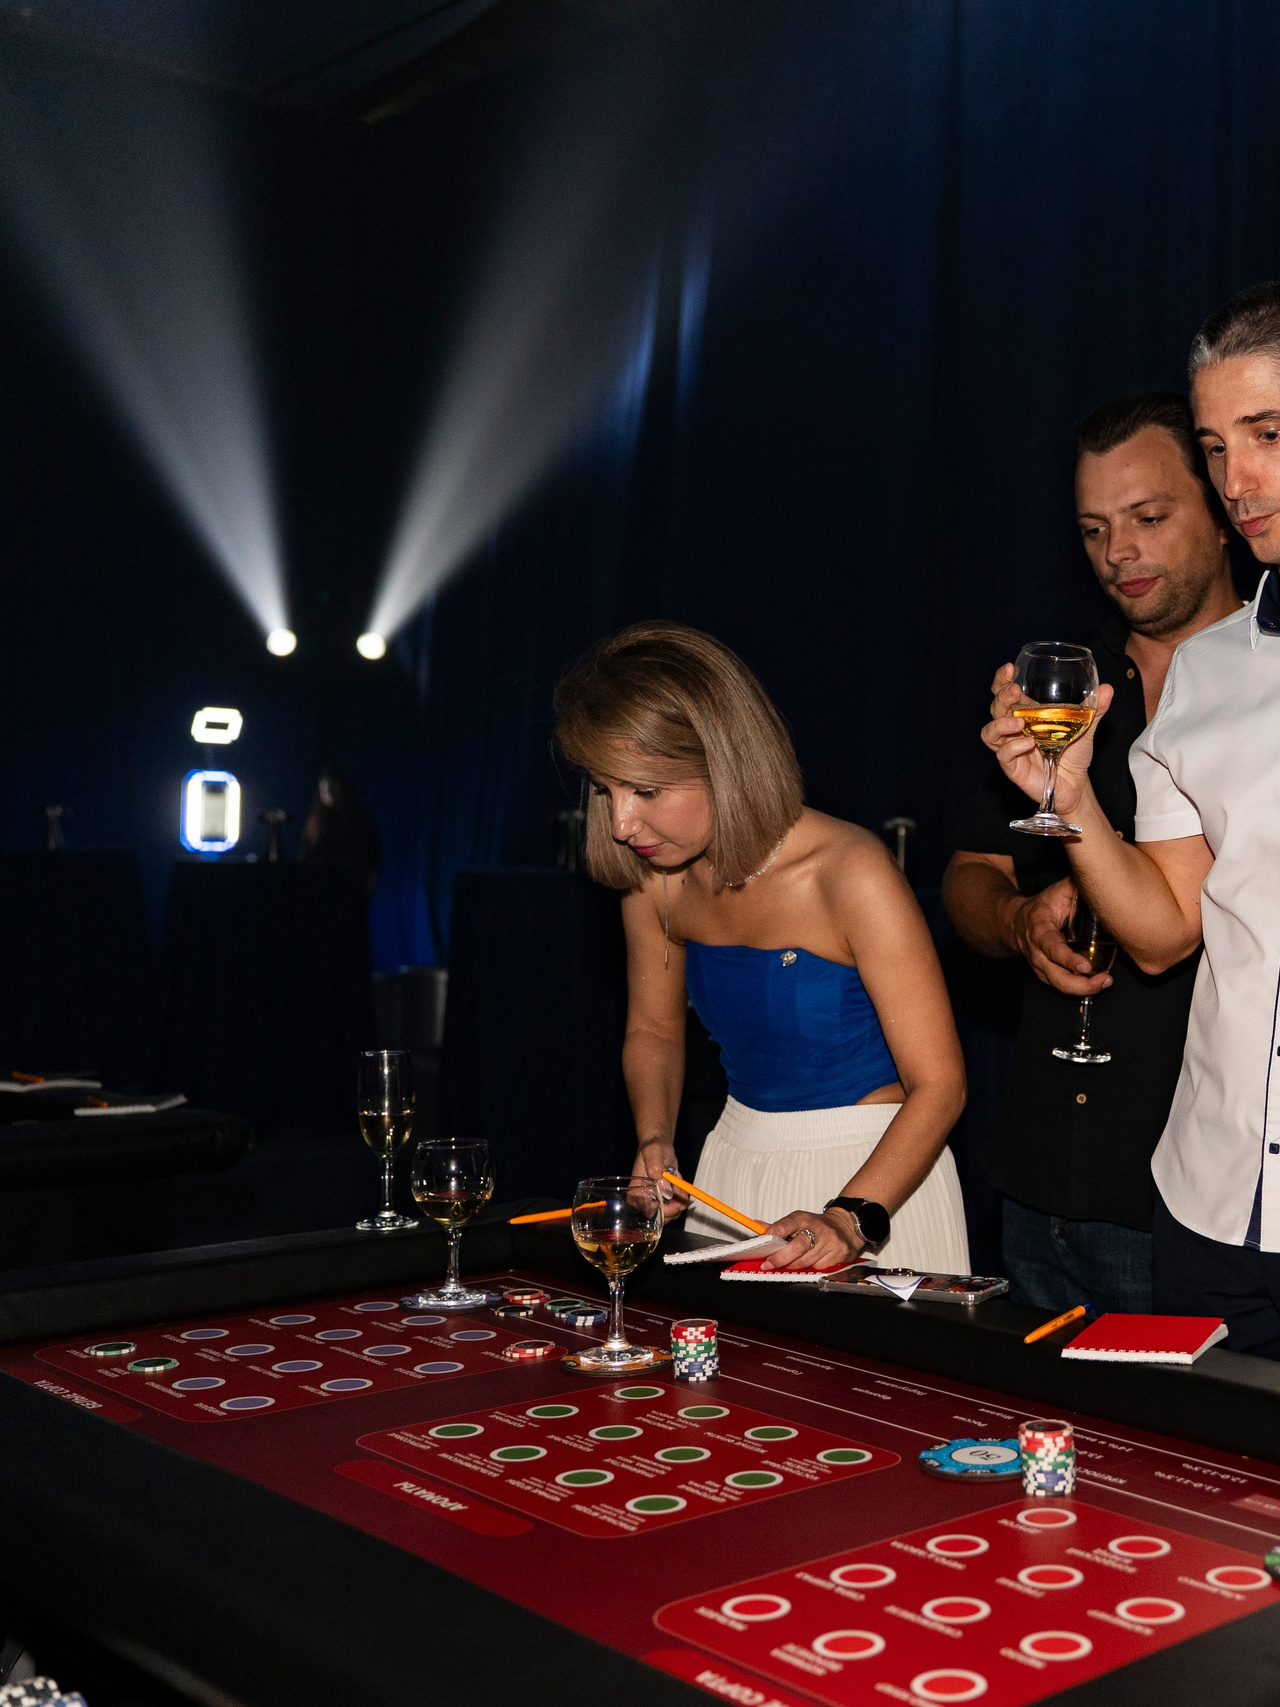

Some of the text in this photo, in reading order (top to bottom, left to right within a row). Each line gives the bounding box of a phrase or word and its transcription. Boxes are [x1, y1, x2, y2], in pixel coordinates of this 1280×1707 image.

[34, 1380, 104, 1410] БЕЛЫЕ СОРТА
[970, 1450, 1001, 1461] 50
[1076, 1467, 1127, 1485] КРЕПОСТ
[394, 1481, 468, 1511] АРОМАТЫ
[694, 1670, 765, 1706] СОРТА
